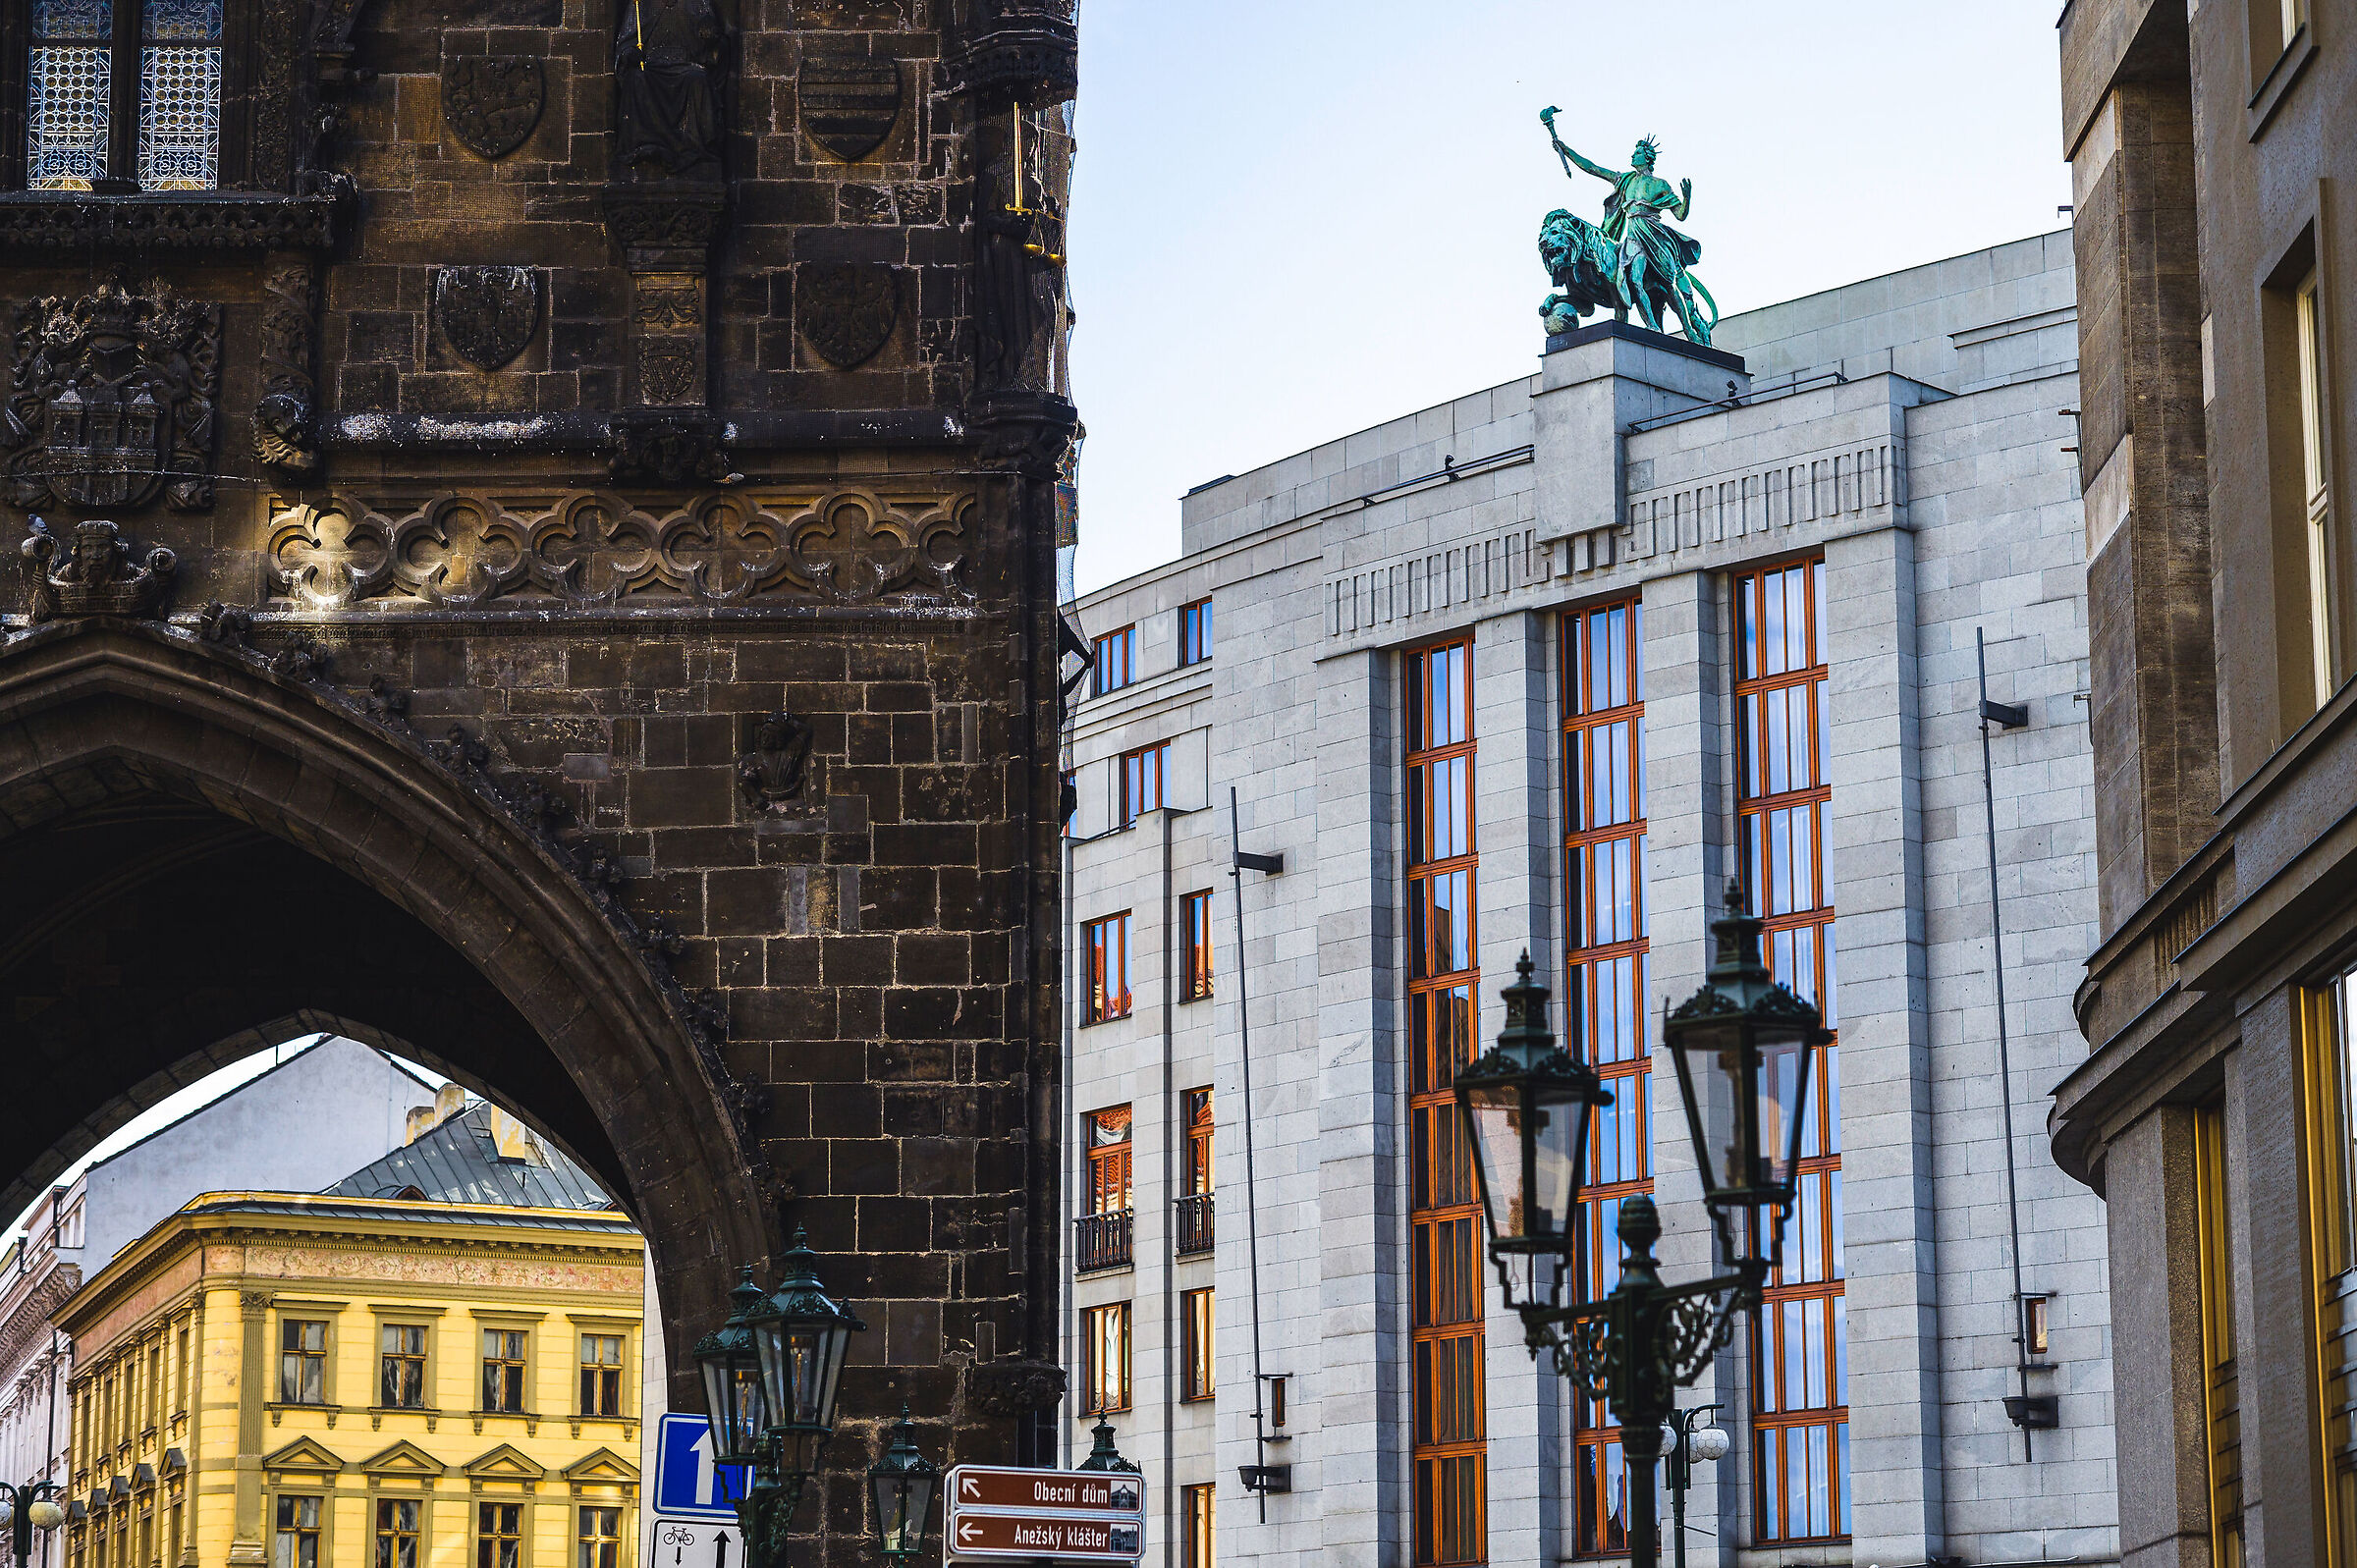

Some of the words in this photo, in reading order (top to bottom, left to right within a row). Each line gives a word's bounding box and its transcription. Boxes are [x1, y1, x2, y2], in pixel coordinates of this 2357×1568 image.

[1034, 1482, 1075, 1502] Obecní
[1082, 1484, 1107, 1503] dům
[1014, 1524, 1062, 1549] Anežský
[1068, 1527, 1107, 1546] klášter
